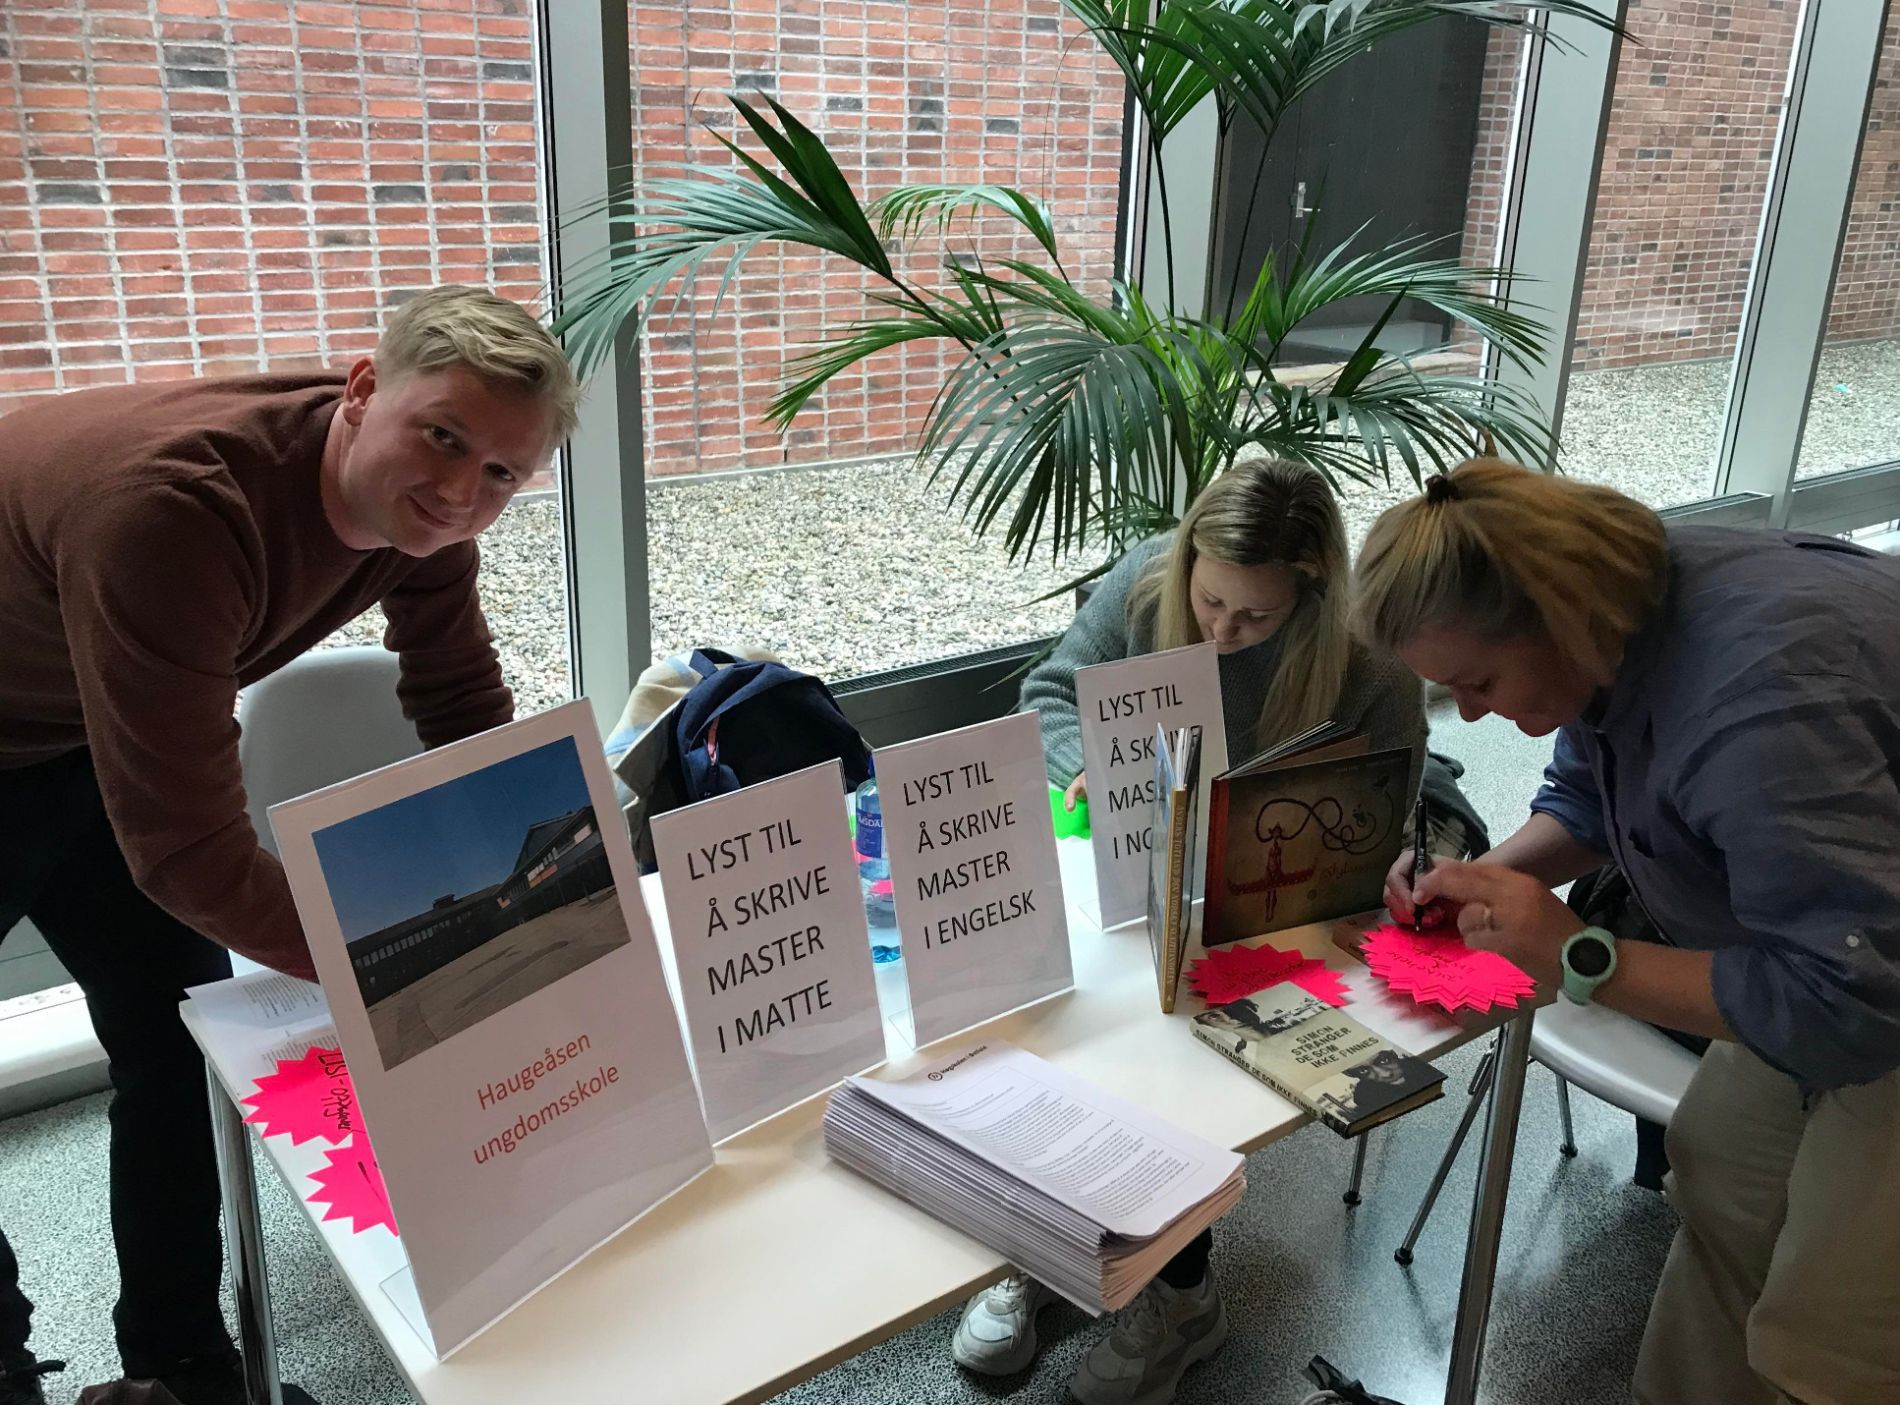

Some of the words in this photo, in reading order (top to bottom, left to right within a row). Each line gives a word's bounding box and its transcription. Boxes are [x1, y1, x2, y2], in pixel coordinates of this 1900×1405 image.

[1099, 690, 1147, 722] LYST
[1151, 684, 1183, 709] TIL
[1110, 737, 1125, 767] Å
[1130, 725, 1202, 762] SKIE
[903, 770, 956, 806] LYST
[960, 761, 995, 788] TIL
[1108, 780, 1157, 813] MAS
[687, 831, 756, 881] LYST
[759, 818, 802, 853] TIL
[918, 820, 935, 854] Å
[939, 801, 1016, 846] SKRIVE
[1113, 836, 1119, 860] I
[917, 850, 1011, 901] MASTER
[708, 897, 729, 938] Å
[734, 865, 830, 926] SKRIVE
[923, 925, 931, 950] I
[938, 888, 1037, 944] ENGELSK
[707, 925, 826, 996] MASTER
[717, 1025, 727, 1054] I
[735, 979, 833, 1046] MATTE
[1291, 1027, 1352, 1056] STRANGER
[1296, 1025, 1334, 1044] SIMON
[476, 1031, 593, 1111] Haugeåsen
[1216, 1043, 1250, 1069] STRANGER
[1252, 1066, 1261, 1077] DE
[1261, 1073, 1276, 1087] SOM
[1276, 1084, 1292, 1098] IKKE
[1295, 1054, 1313, 1064] DE
[1312, 1044, 1339, 1058] SOM
[1310, 1054, 1340, 1068] IKKE
[1339, 1036, 1379, 1058] FINNES
[472, 1063, 620, 1166] ungdomsskole
